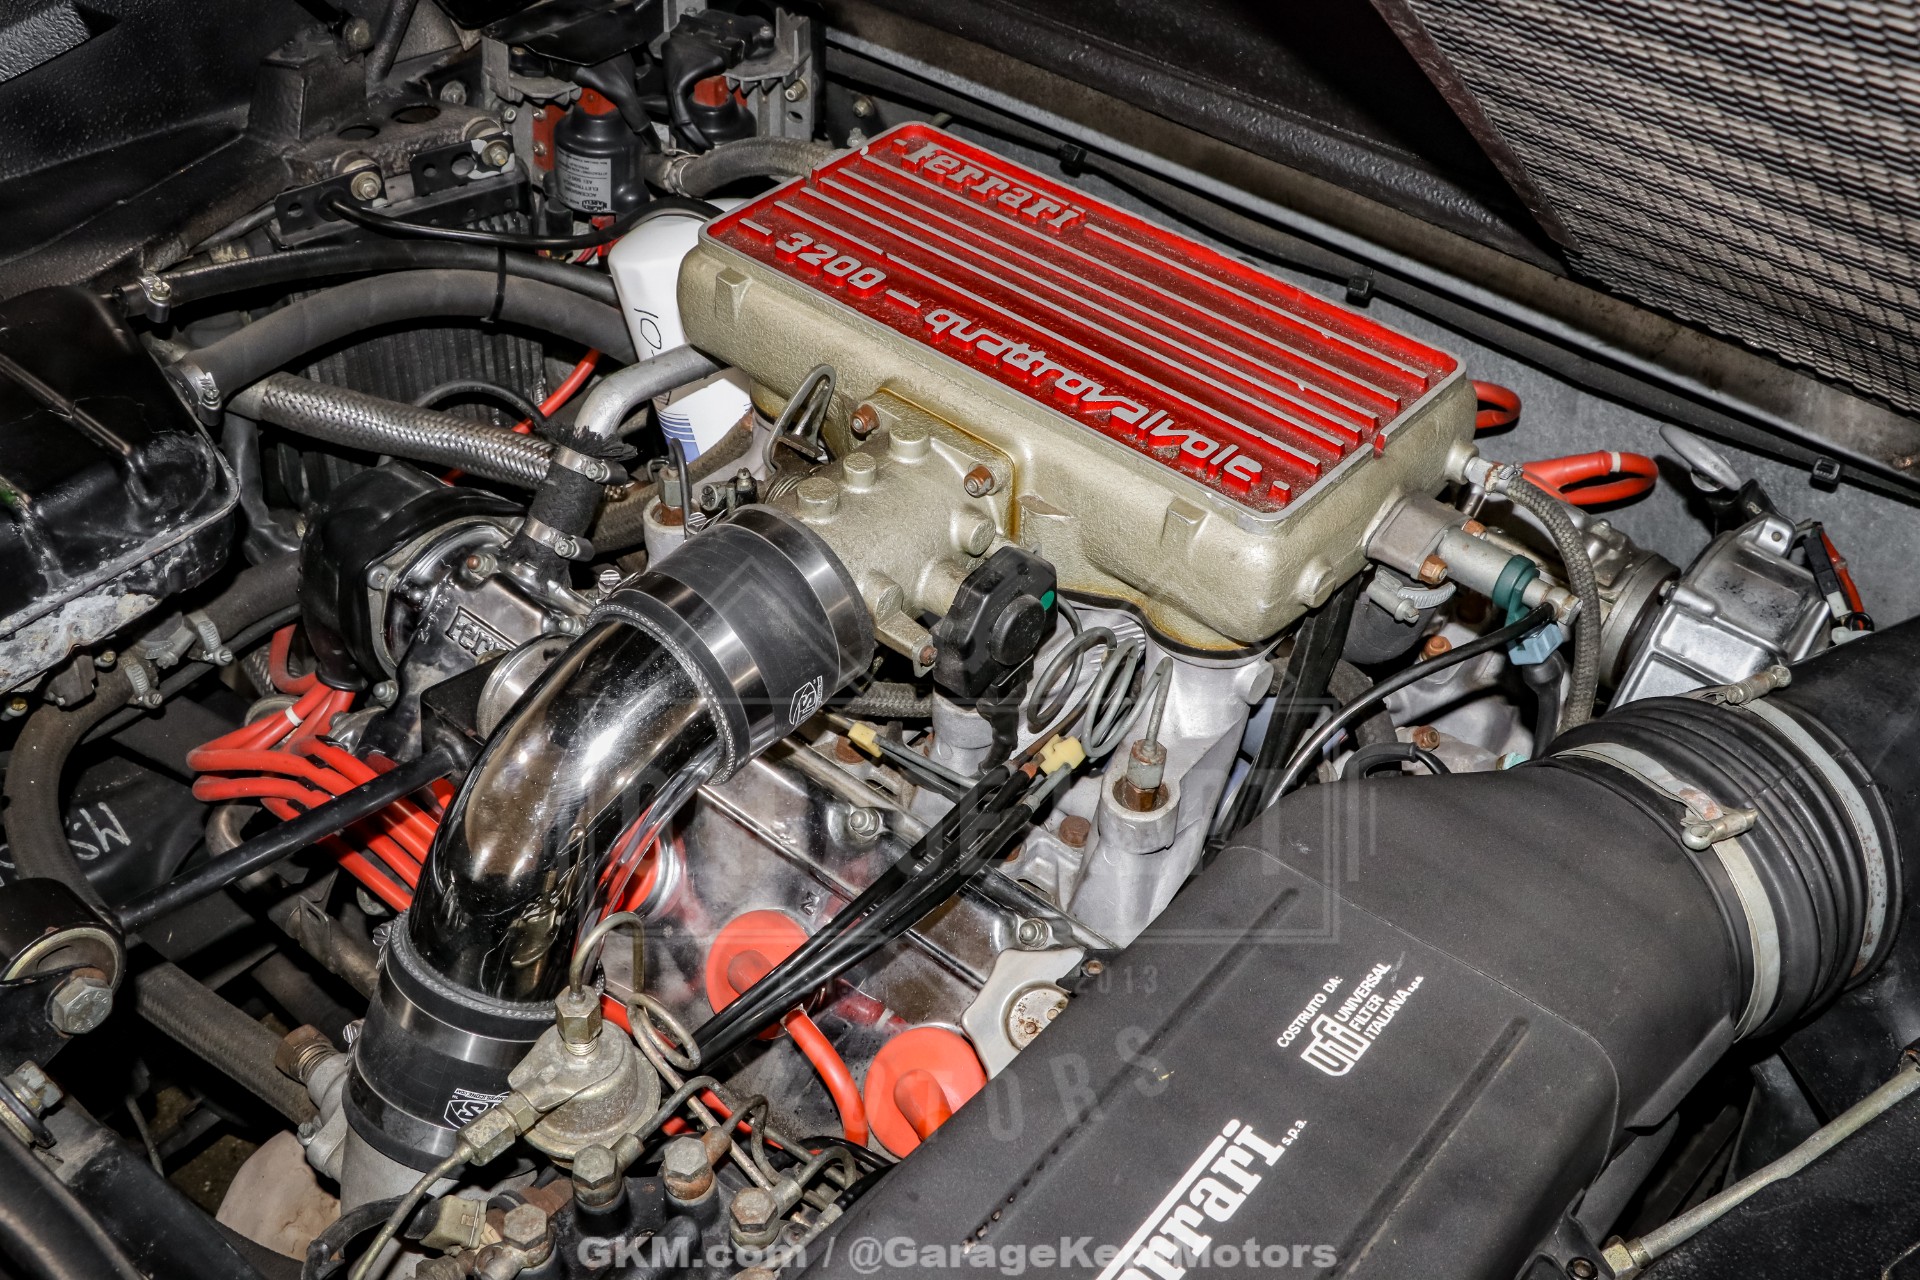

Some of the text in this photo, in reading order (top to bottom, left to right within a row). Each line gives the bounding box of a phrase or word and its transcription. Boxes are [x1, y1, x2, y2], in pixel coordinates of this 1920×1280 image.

[902, 141, 1087, 232] Ferrari
[776, 231, 1263, 488] 3200 quattrovalvole
[1276, 975, 1344, 1048] COSTRUITO DA:
[1333, 962, 1392, 1022] UNIVERSAL
[1348, 993, 1386, 1032] FILTER
[1363, 989, 1412, 1040] ITALIANA
[1096, 1118, 1287, 1280] rrari
